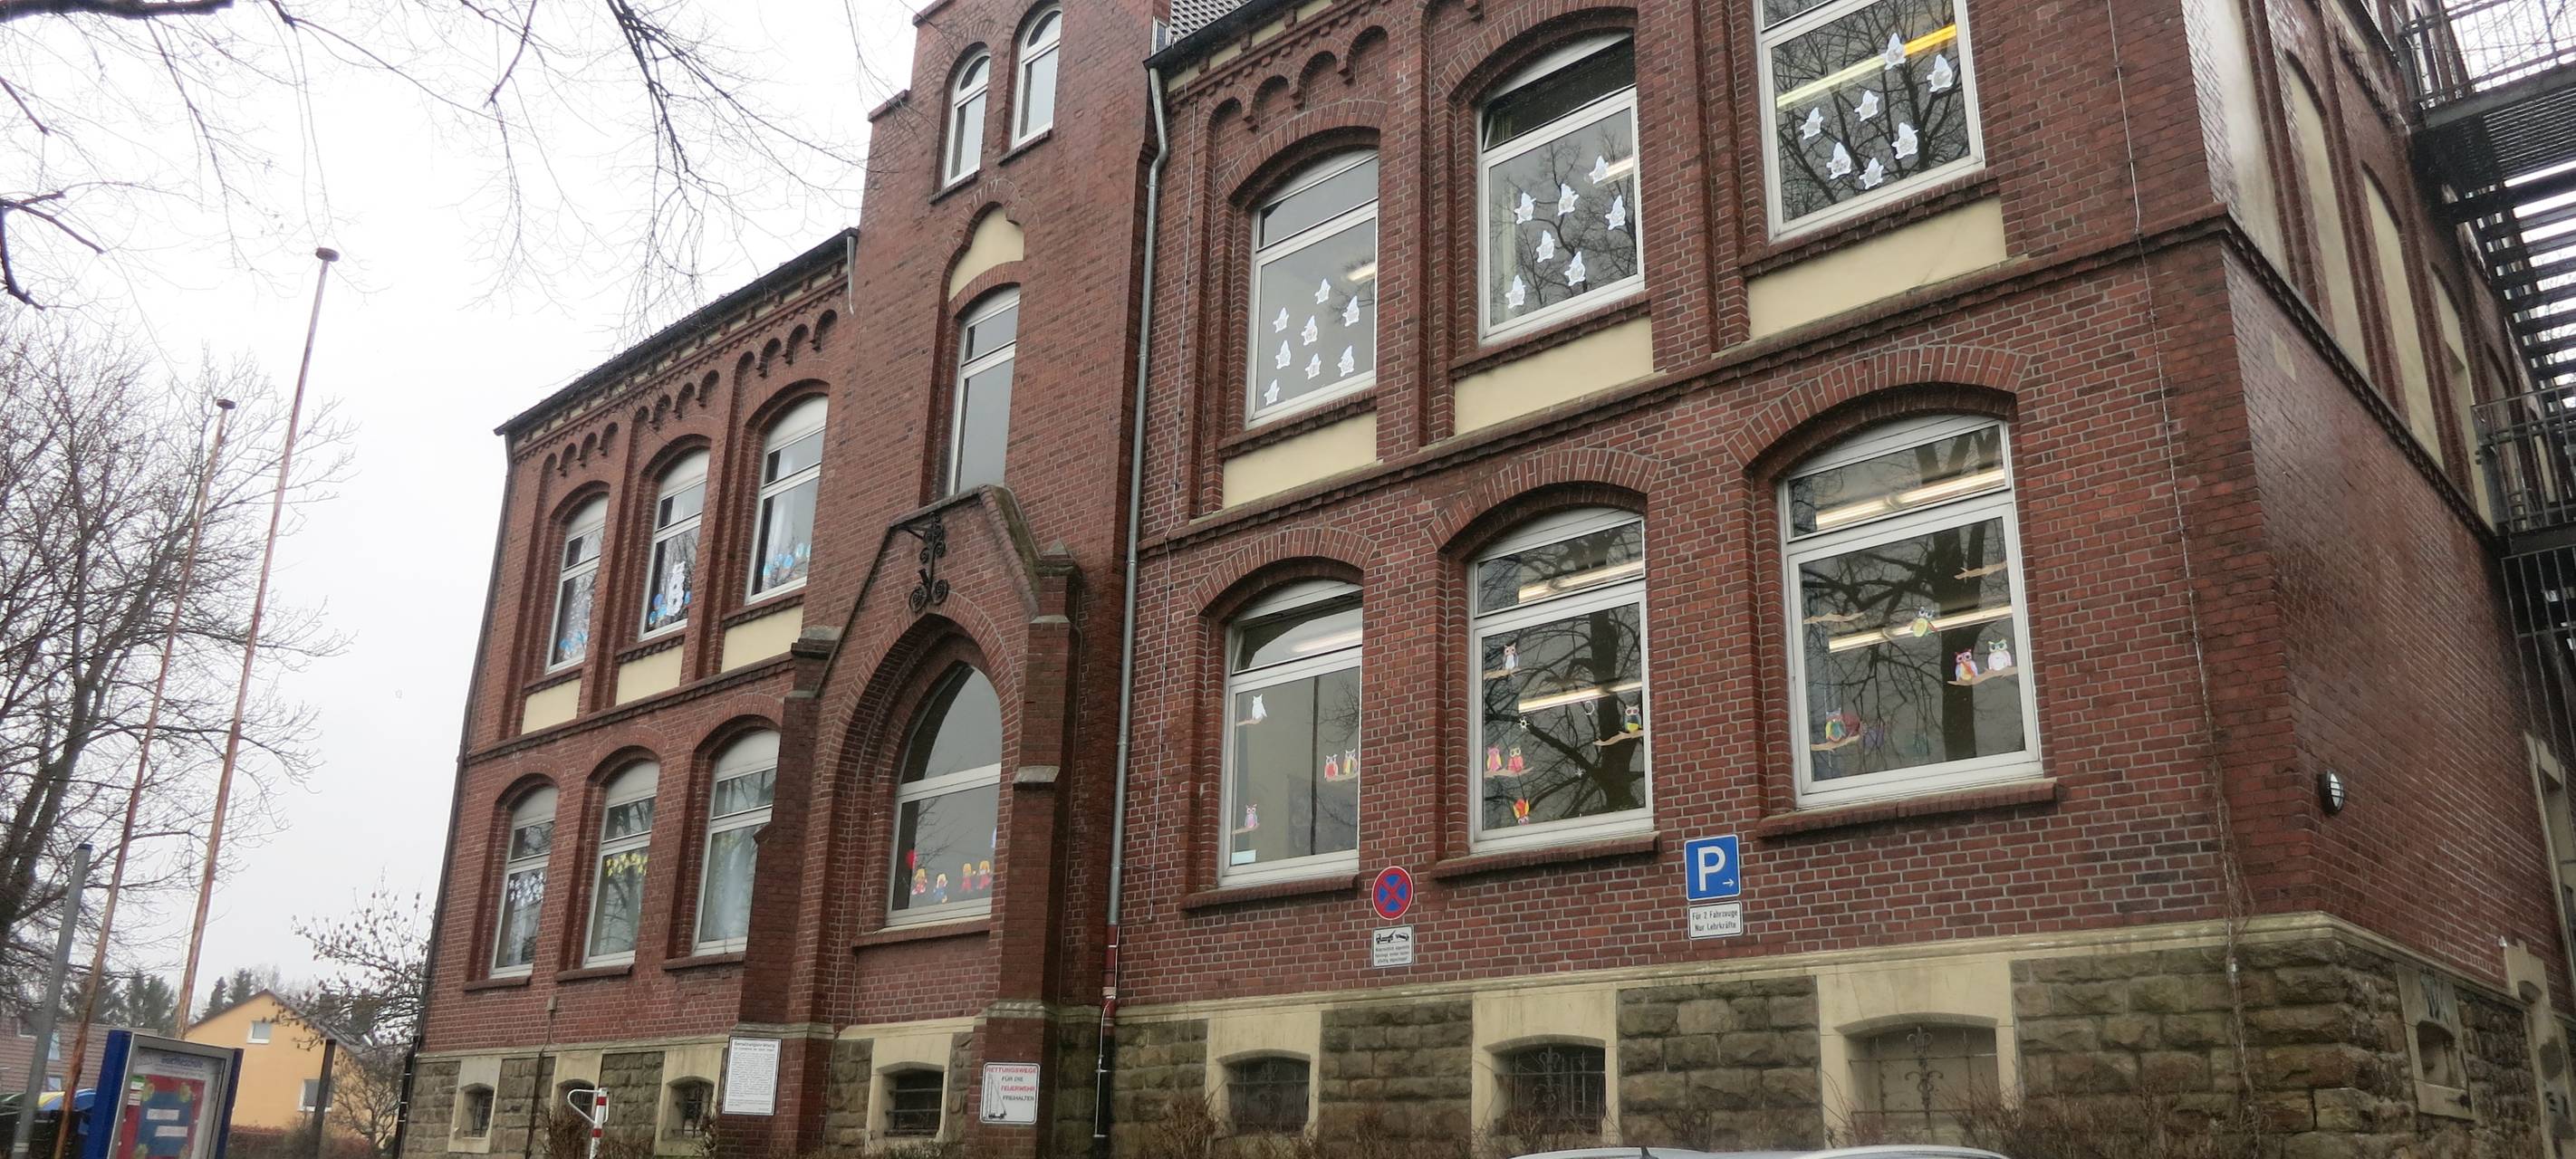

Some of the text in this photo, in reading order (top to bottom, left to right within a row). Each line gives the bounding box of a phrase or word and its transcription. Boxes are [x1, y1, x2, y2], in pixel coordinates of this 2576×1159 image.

[1697, 846, 1725, 892] P
[1710, 910, 1737, 919] Fahrzeuge
[1706, 922, 1736, 931] Lehrkräfte
